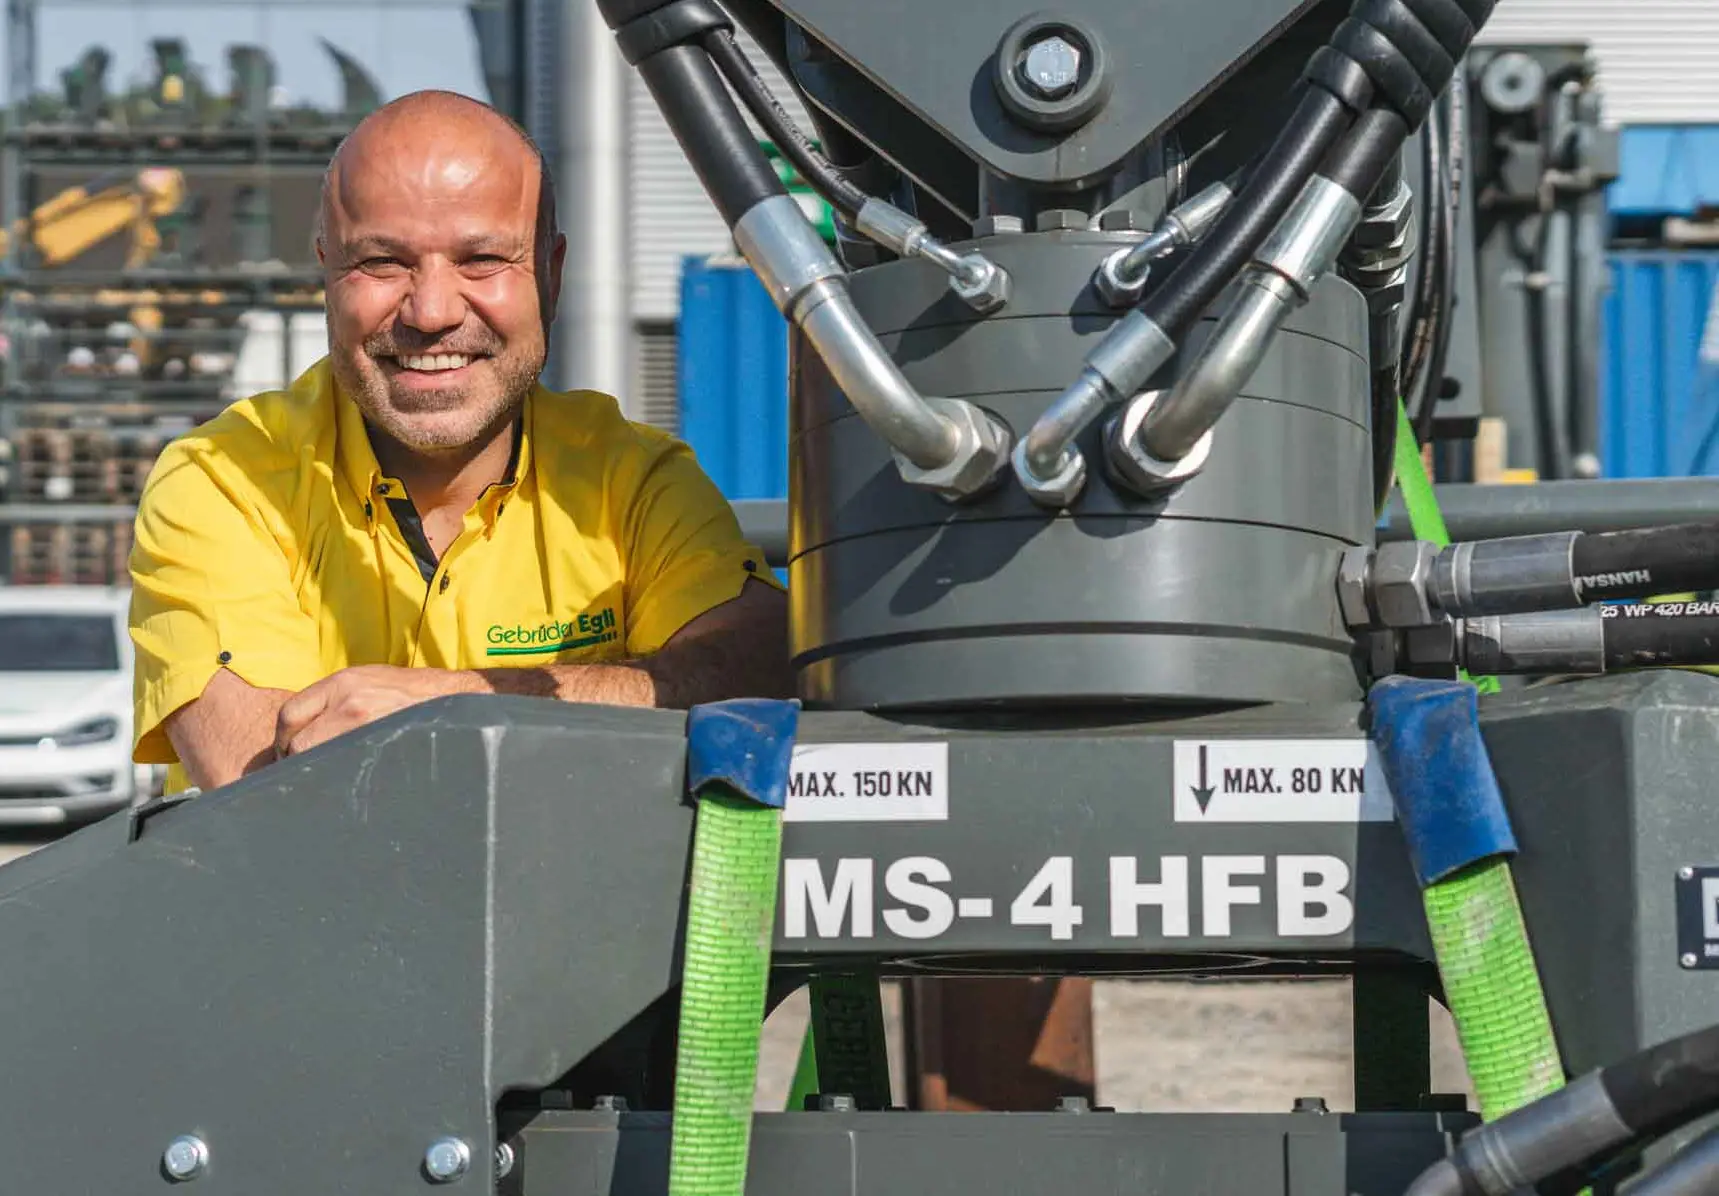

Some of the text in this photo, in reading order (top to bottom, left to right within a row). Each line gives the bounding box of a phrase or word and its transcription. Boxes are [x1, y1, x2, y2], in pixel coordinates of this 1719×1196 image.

[1624, 603, 1654, 618] WP
[1654, 602, 1684, 617] 420
[486, 607, 616, 644] Gebrüder Egli
[788, 770, 933, 797] MAX. 150 KN
[1223, 767, 1365, 794] MAX. 80 KN
[1109, 855, 1354, 937] HFB
